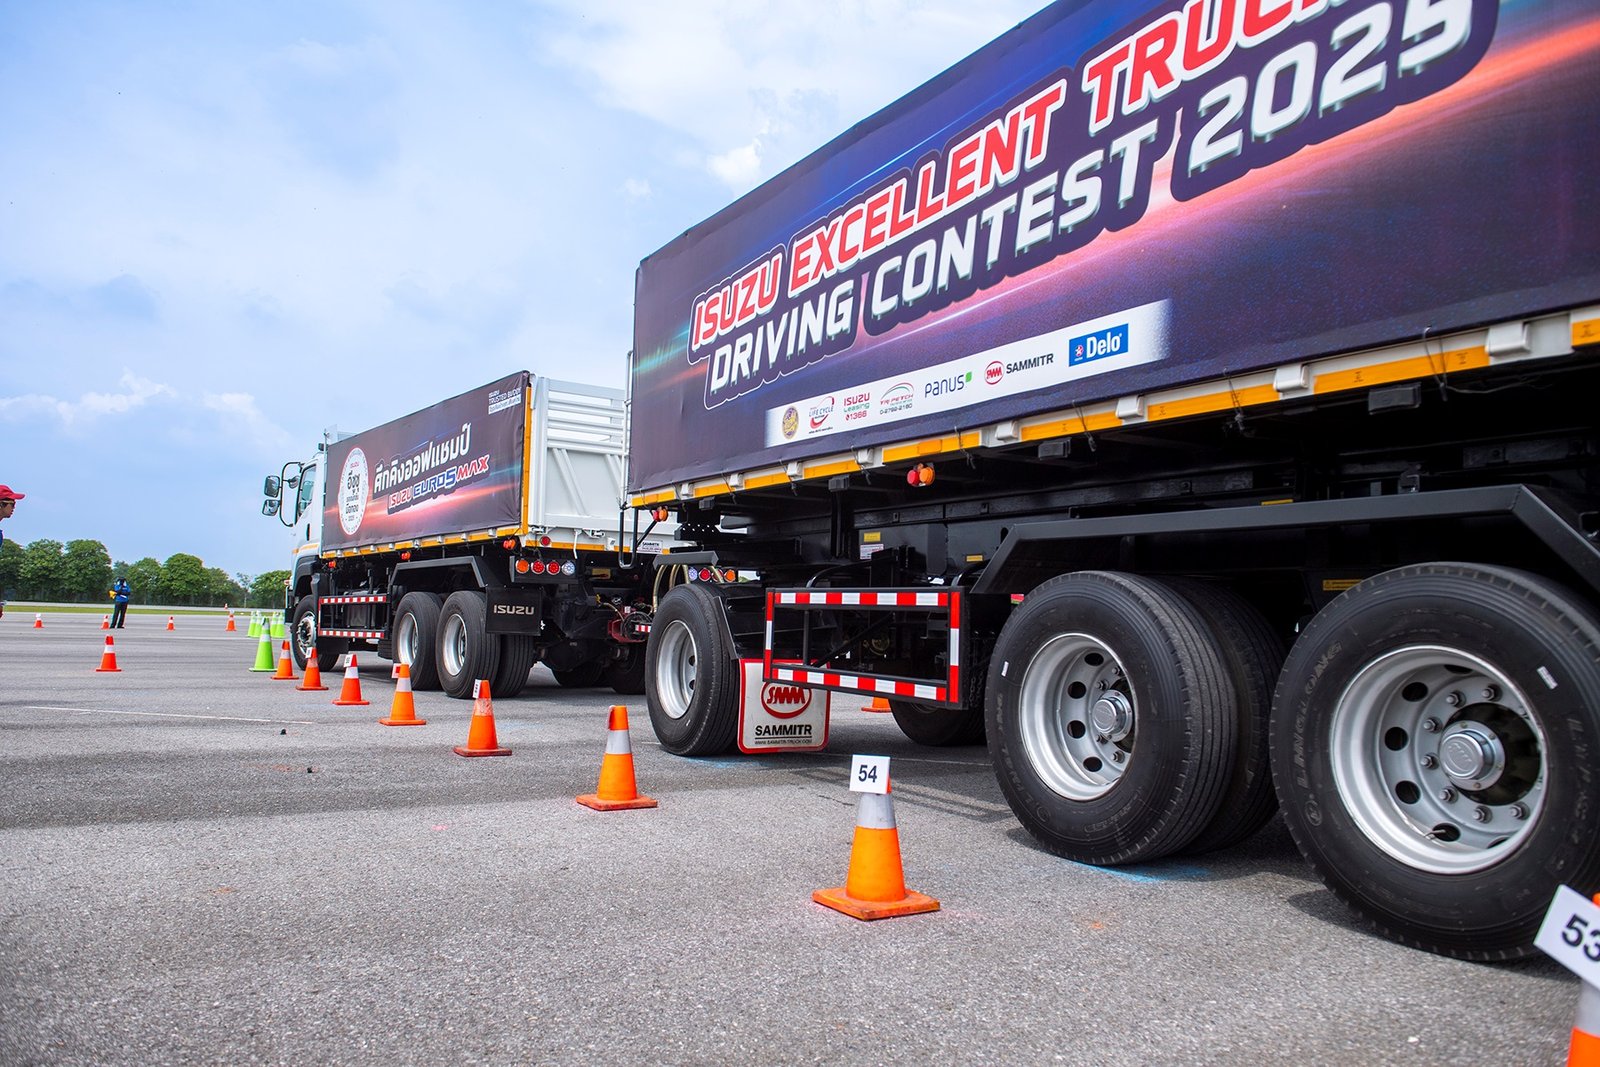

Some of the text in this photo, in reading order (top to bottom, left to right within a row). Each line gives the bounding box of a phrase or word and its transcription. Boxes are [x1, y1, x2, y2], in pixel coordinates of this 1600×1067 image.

[692, 0, 1346, 350] ISUZU EXCELLENT TRU
[710, 0, 1472, 395] DRIVING CONTEST 2025
[1086, 331, 1121, 358] Delo
[1006, 353, 1054, 374] SAMMITR
[843, 392, 870, 406] ISUZU
[493, 604, 535, 615] ISUZU
[755, 724, 812, 736] SAMMITR
[858, 764, 878, 783] 54
[1561, 913, 1600, 962] 53
